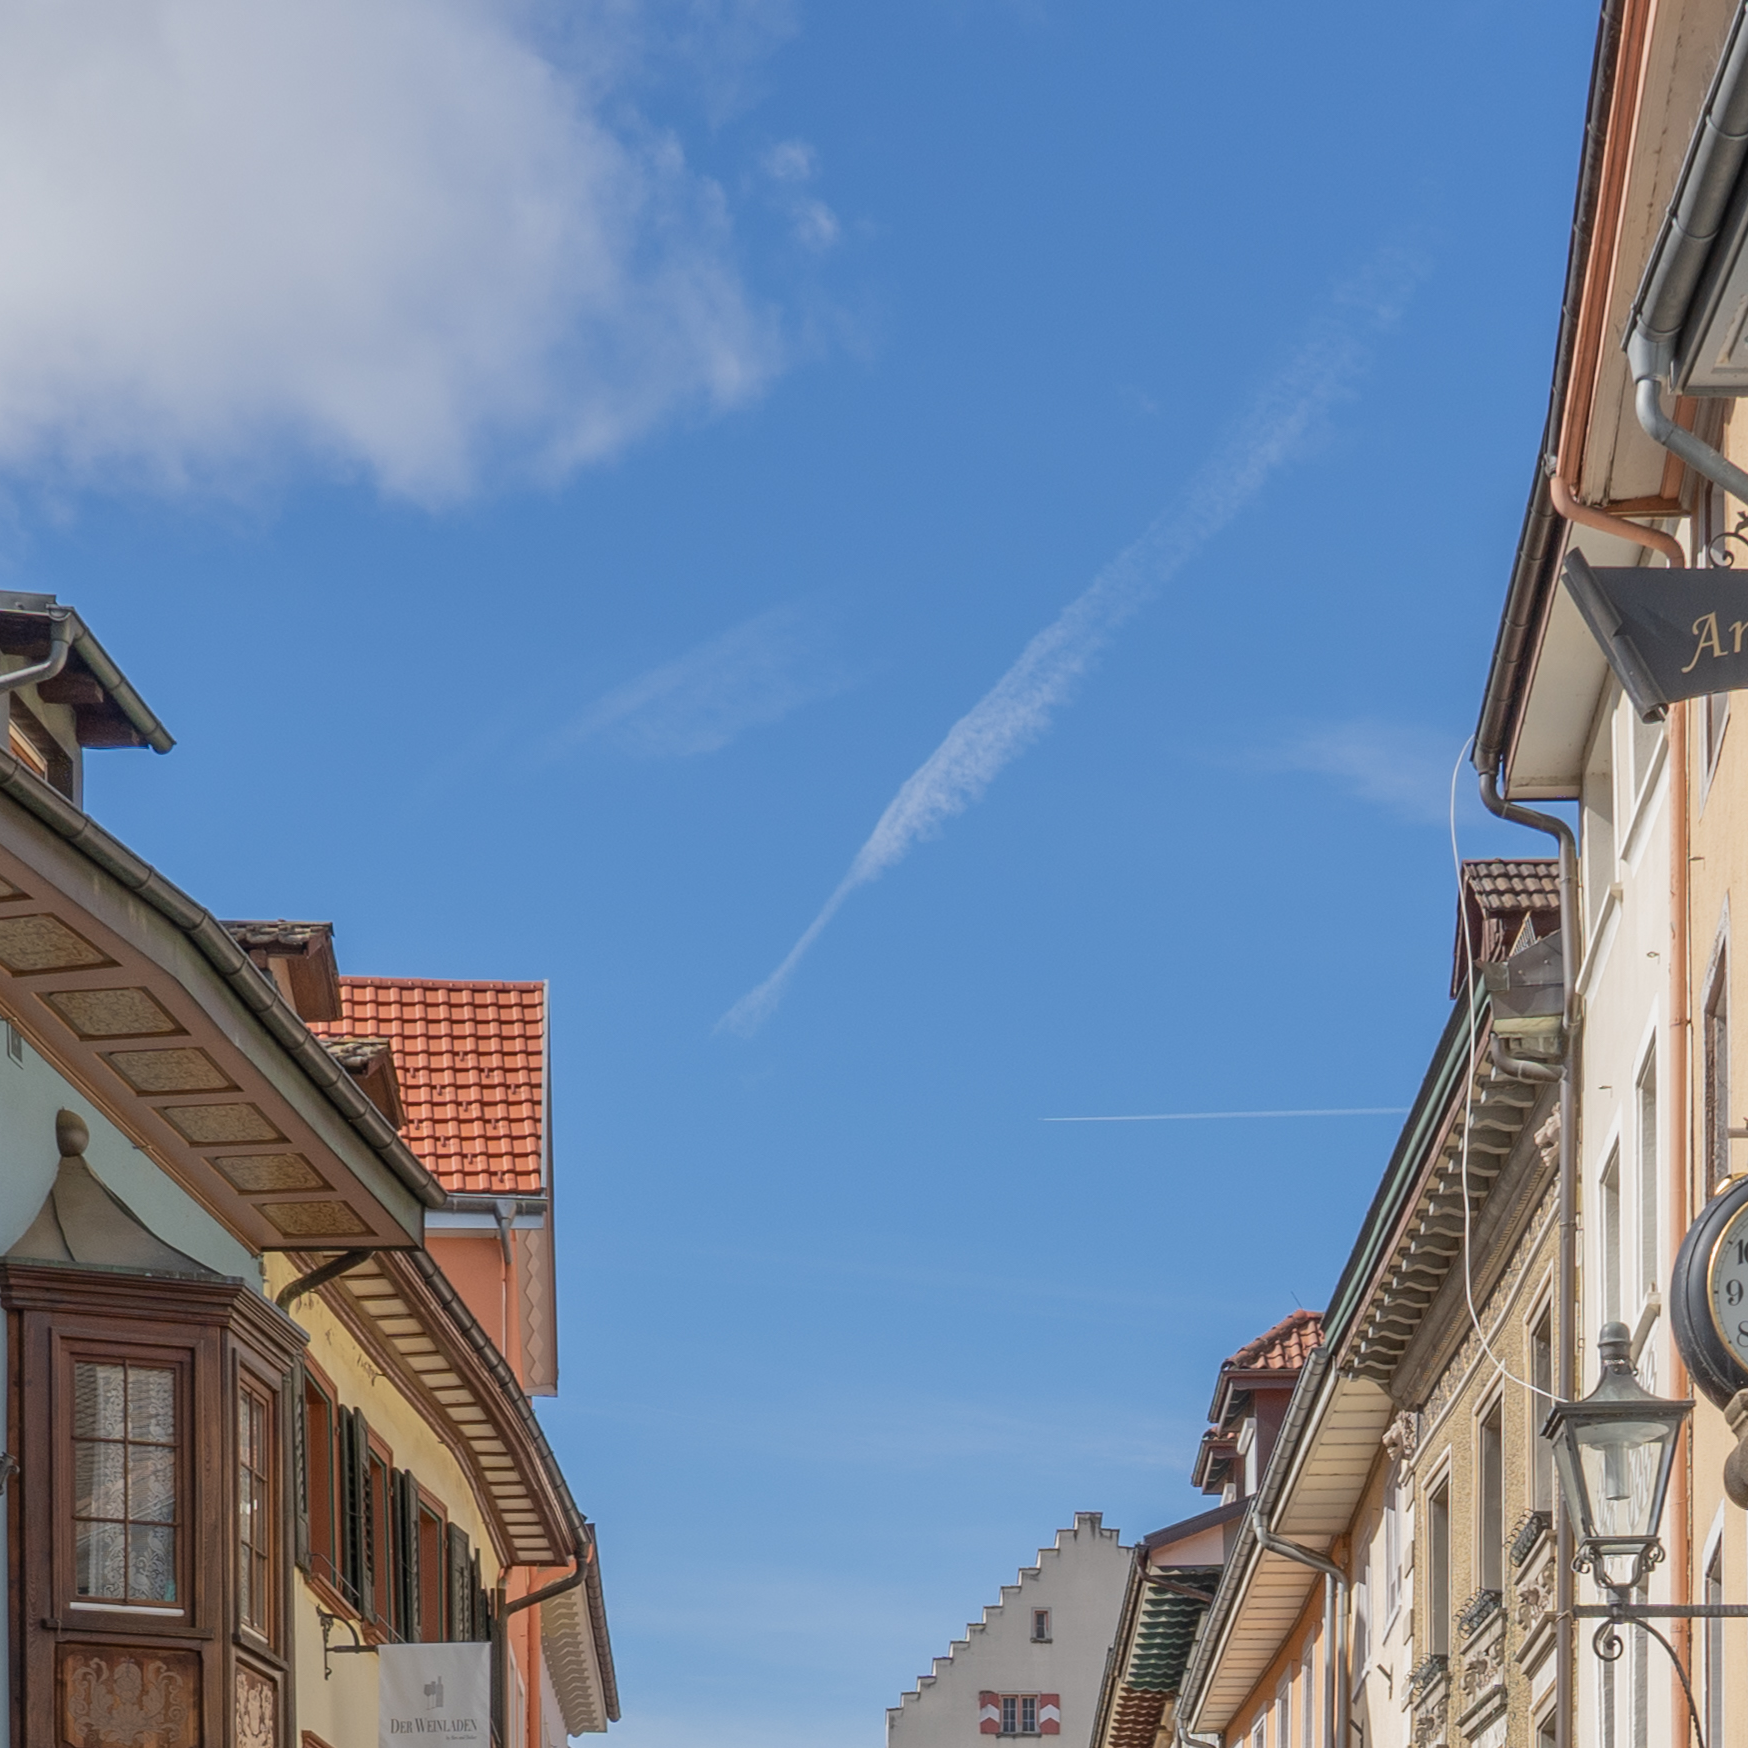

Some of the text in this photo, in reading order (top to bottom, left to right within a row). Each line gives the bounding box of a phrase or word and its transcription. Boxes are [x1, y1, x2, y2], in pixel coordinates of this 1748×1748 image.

[1726, 1279, 1744, 1306] 9
[390, 1717, 478, 1734] DER WEINLADEN
